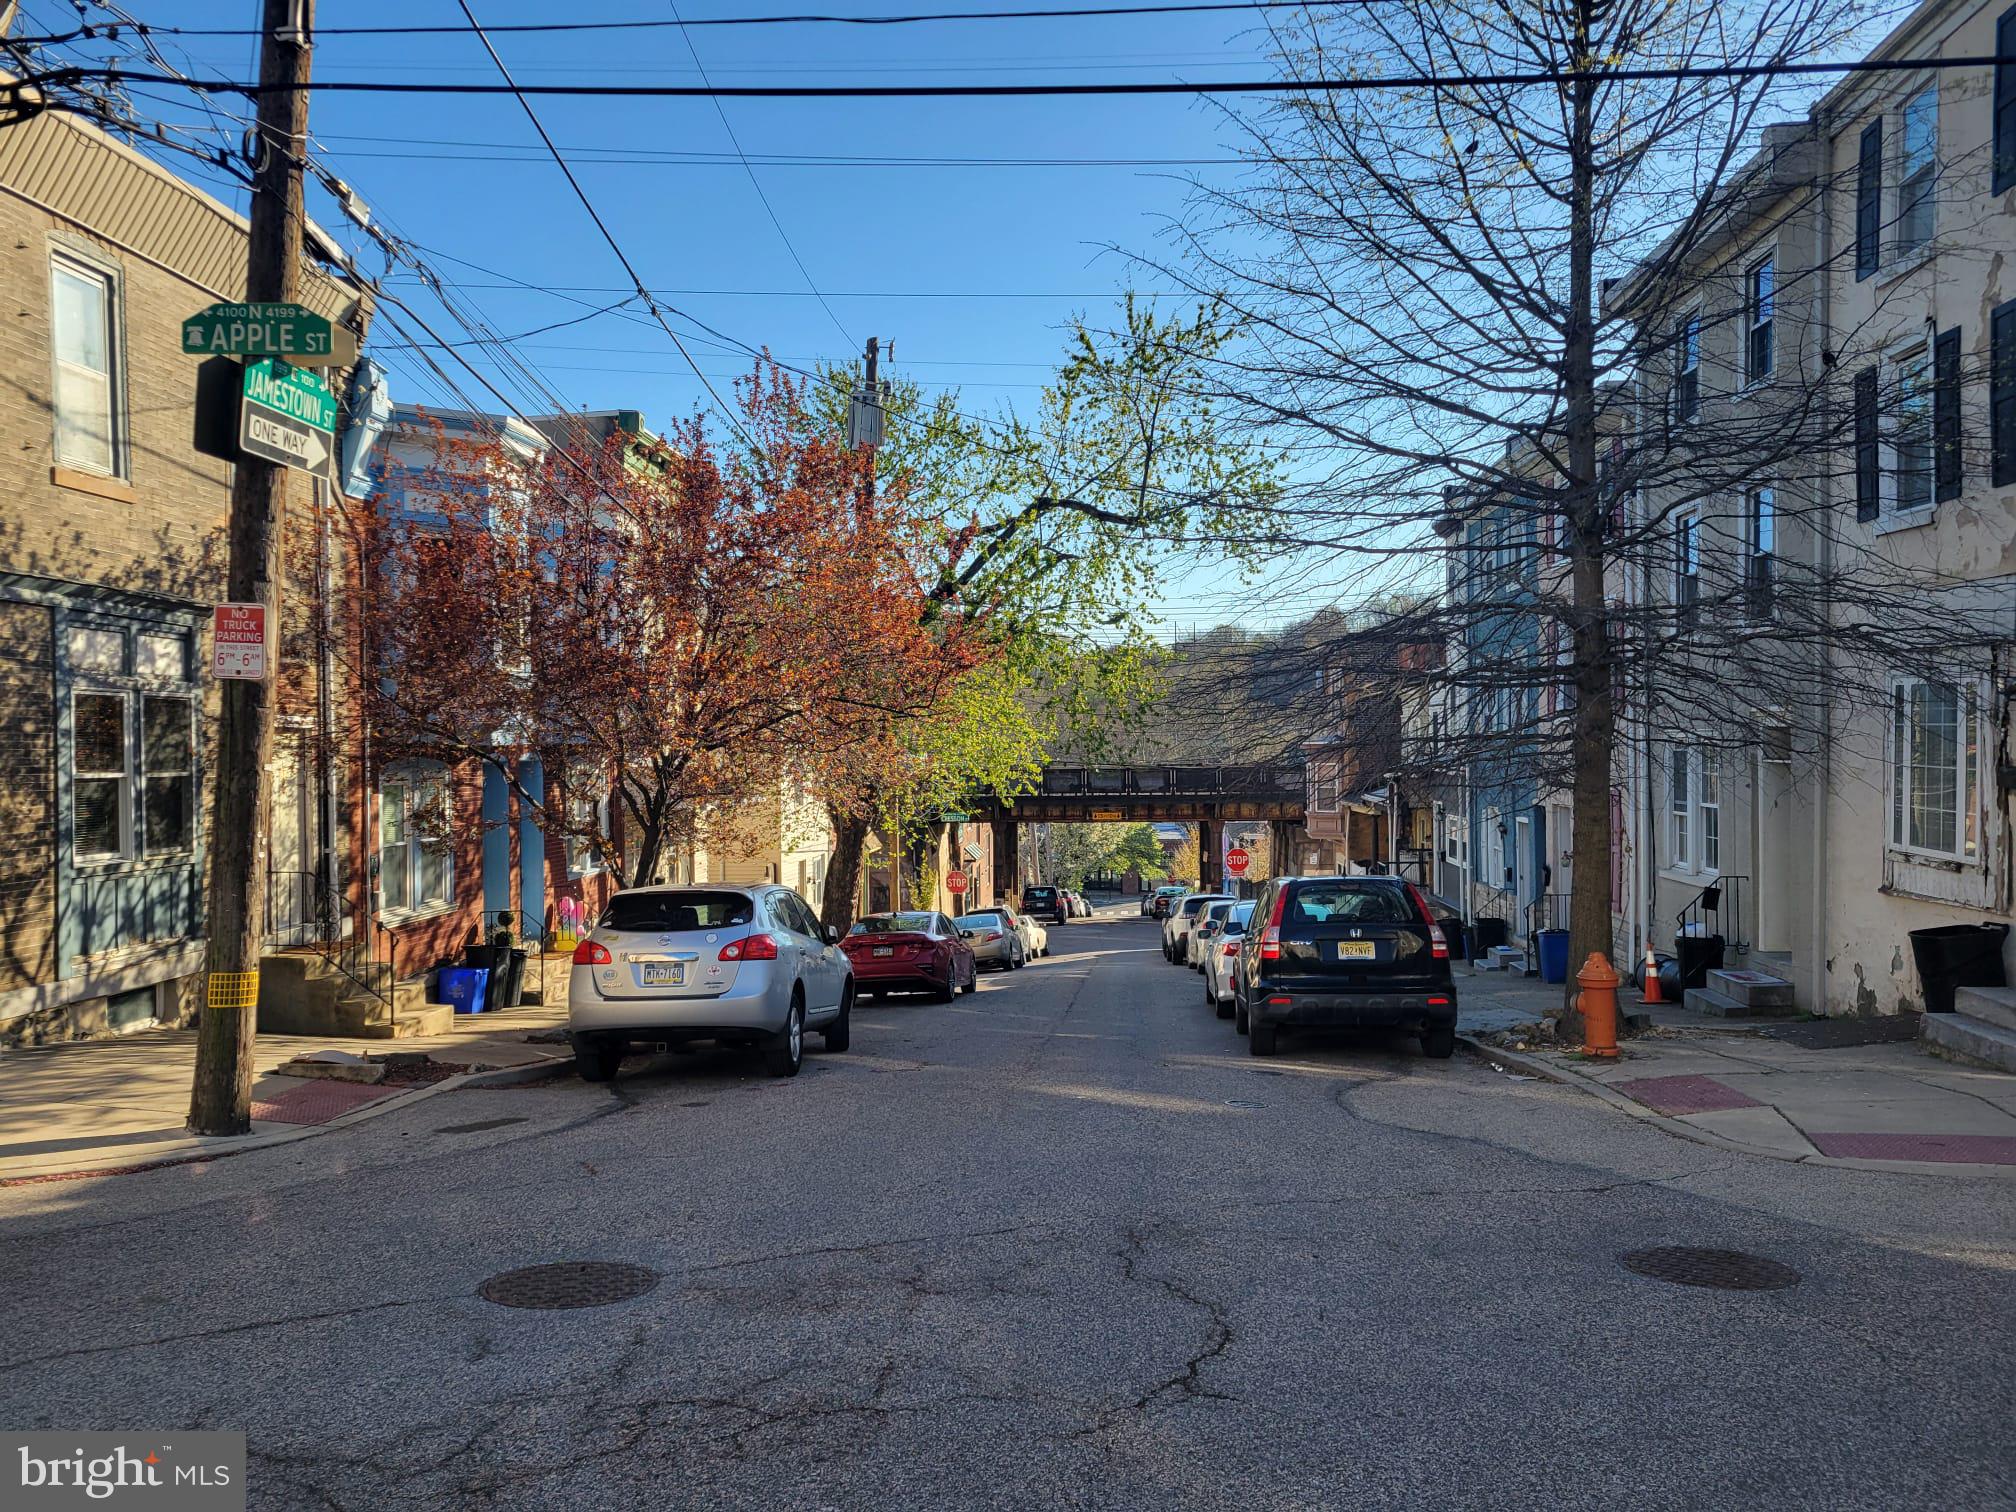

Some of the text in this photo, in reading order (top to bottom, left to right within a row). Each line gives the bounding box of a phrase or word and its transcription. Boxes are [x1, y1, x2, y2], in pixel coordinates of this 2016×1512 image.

[216, 305, 296, 319] 4100 N 4199
[210, 323, 327, 352] APPLE ST
[291, 366, 299, 383] E
[247, 368, 322, 424] JAMESTOWN
[323, 409, 335, 429] ST
[253, 419, 308, 455] ONE WAY
[231, 608, 249, 619] NO
[223, 620, 257, 631] TRUCK
[216, 631, 263, 642] PARKING
[1227, 855, 1248, 865] STOP
[947, 878, 967, 888] STOP
